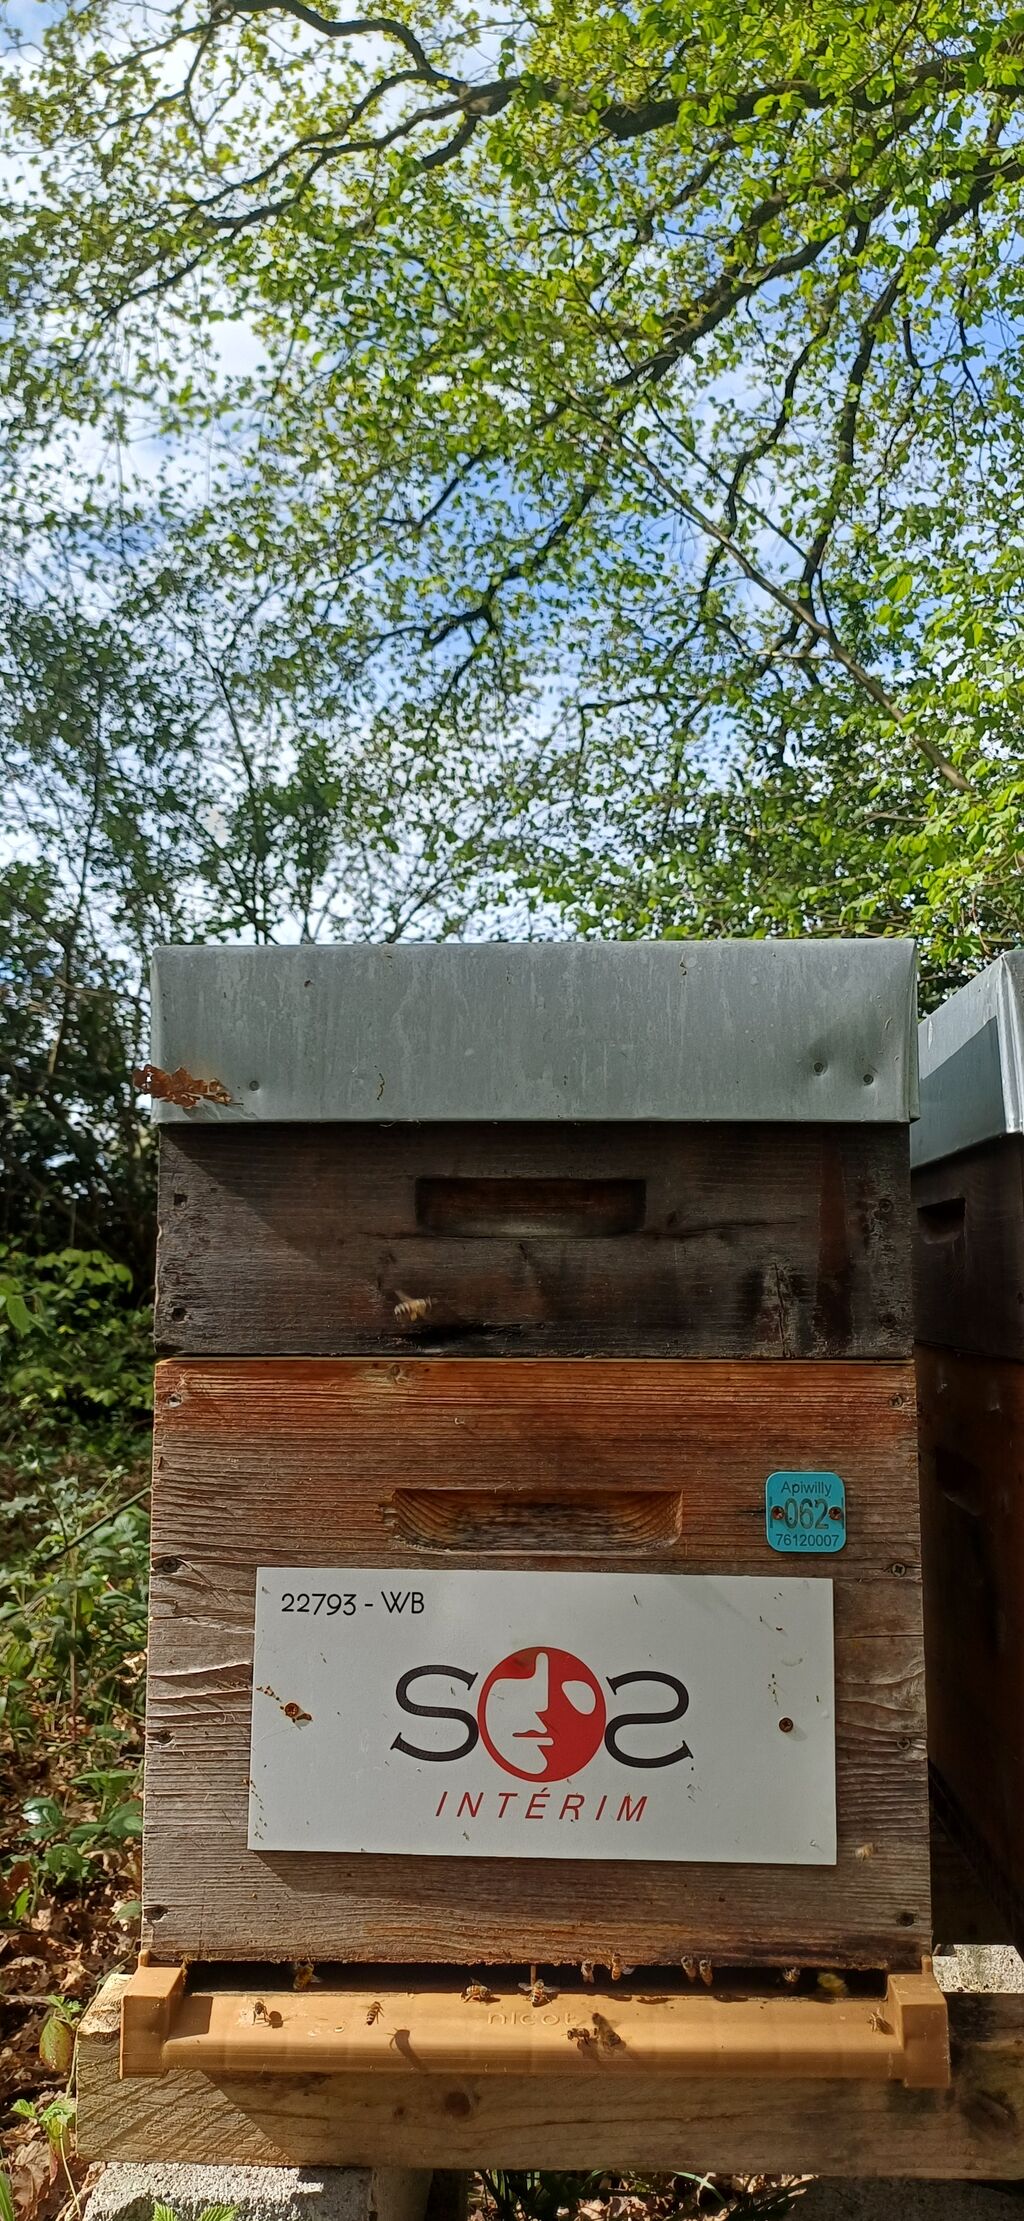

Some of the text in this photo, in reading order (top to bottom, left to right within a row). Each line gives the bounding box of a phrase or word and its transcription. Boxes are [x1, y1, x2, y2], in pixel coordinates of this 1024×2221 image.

[781, 1481, 832, 1497] Apiwilly
[784, 1498, 829, 1530] 062
[776, 1534, 840, 1547] 76120007
[281, 1591, 357, 1616] 22793
[381, 1591, 426, 1615] WB
[435, 1787, 648, 1822] INTÉRIM
